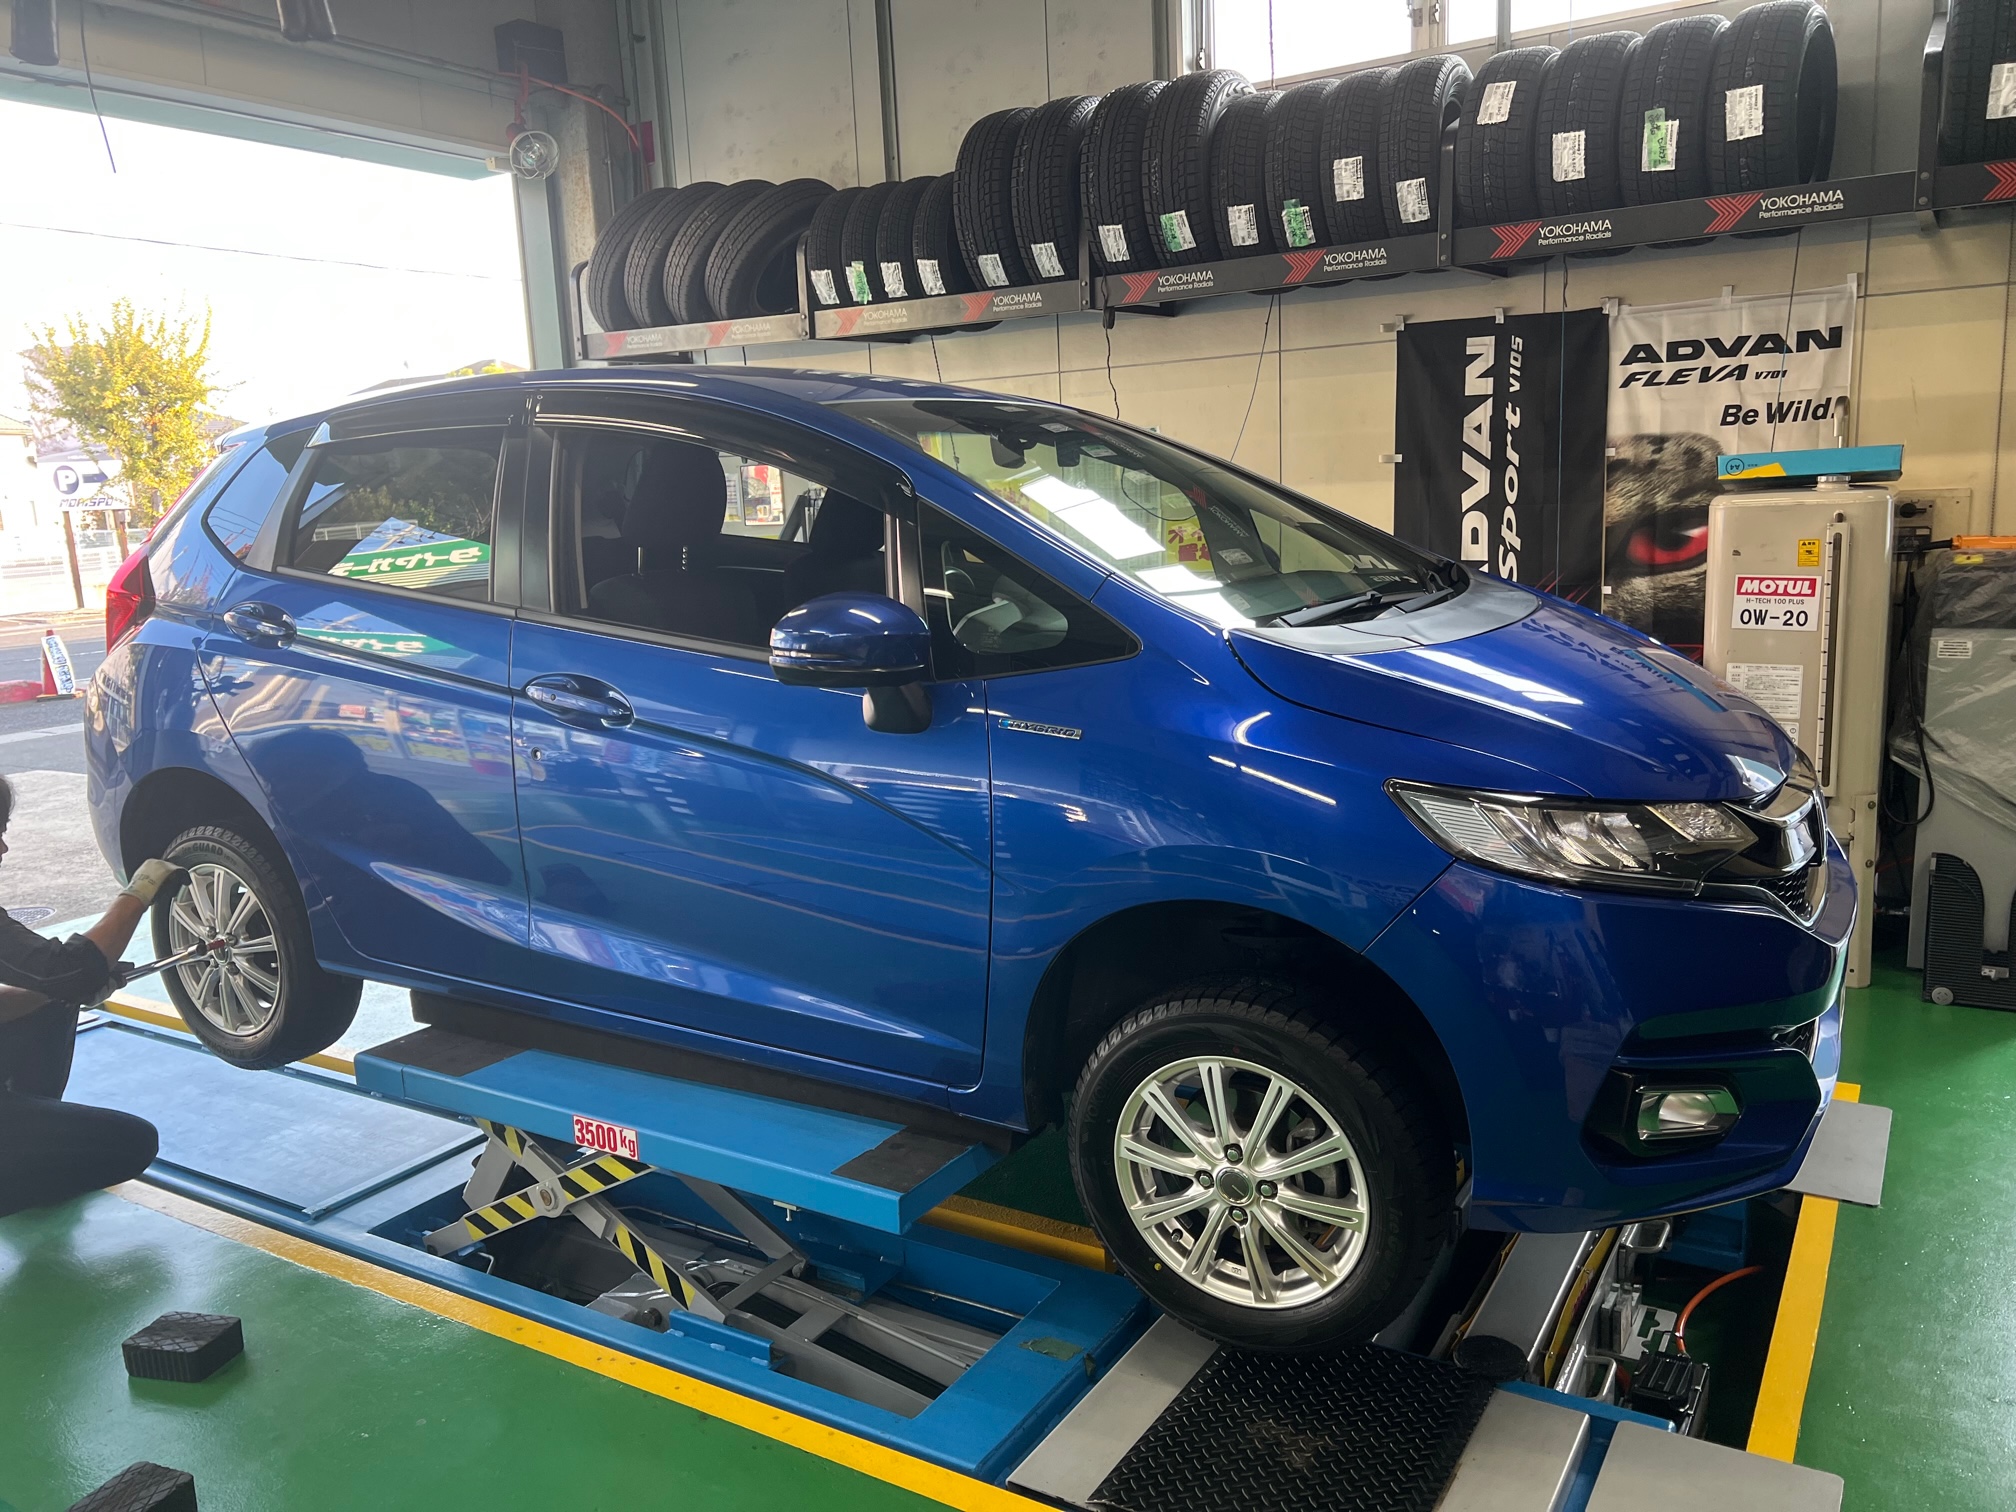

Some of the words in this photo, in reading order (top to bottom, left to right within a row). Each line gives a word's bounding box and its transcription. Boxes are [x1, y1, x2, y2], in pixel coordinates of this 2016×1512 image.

[1759, 189, 1844, 211] YOKOHAMA
[1758, 206, 1812, 219] Performance
[1813, 201, 1844, 214] Radials
[1538, 218, 1612, 238] YOKOHAMA
[1538, 234, 1584, 247] Performance
[1585, 230, 1612, 243] Radials
[1323, 247, 1387, 265] YOKOHAMA
[1323, 261, 1363, 273] Performance
[1364, 258, 1387, 269] Radials
[1157, 269, 1214, 286] YOKOHAMA
[992, 291, 1042, 306] YOKOHAMA
[863, 307, 908, 320] YOKOHAMA
[731, 322, 771, 333] YOKOHAMA
[626, 333, 663, 345] YOKOHAMA
[1618, 325, 1844, 366] ADVAN
[1508, 335, 1524, 393] V105
[1618, 363, 1749, 389] FLEVA
[1754, 367, 1788, 380] V701
[1719, 403, 1759, 427] Be
[1460, 335, 1496, 573] DVAN
[56, 469, 77, 492] P
[1740, 578, 1813, 595] MOTUL
[1745, 597, 1772, 605] H-TECH
[1788, 598, 1805, 606] PLUS
[574, 1118, 618, 1153] 3500
[620, 1128, 636, 1158] kg
